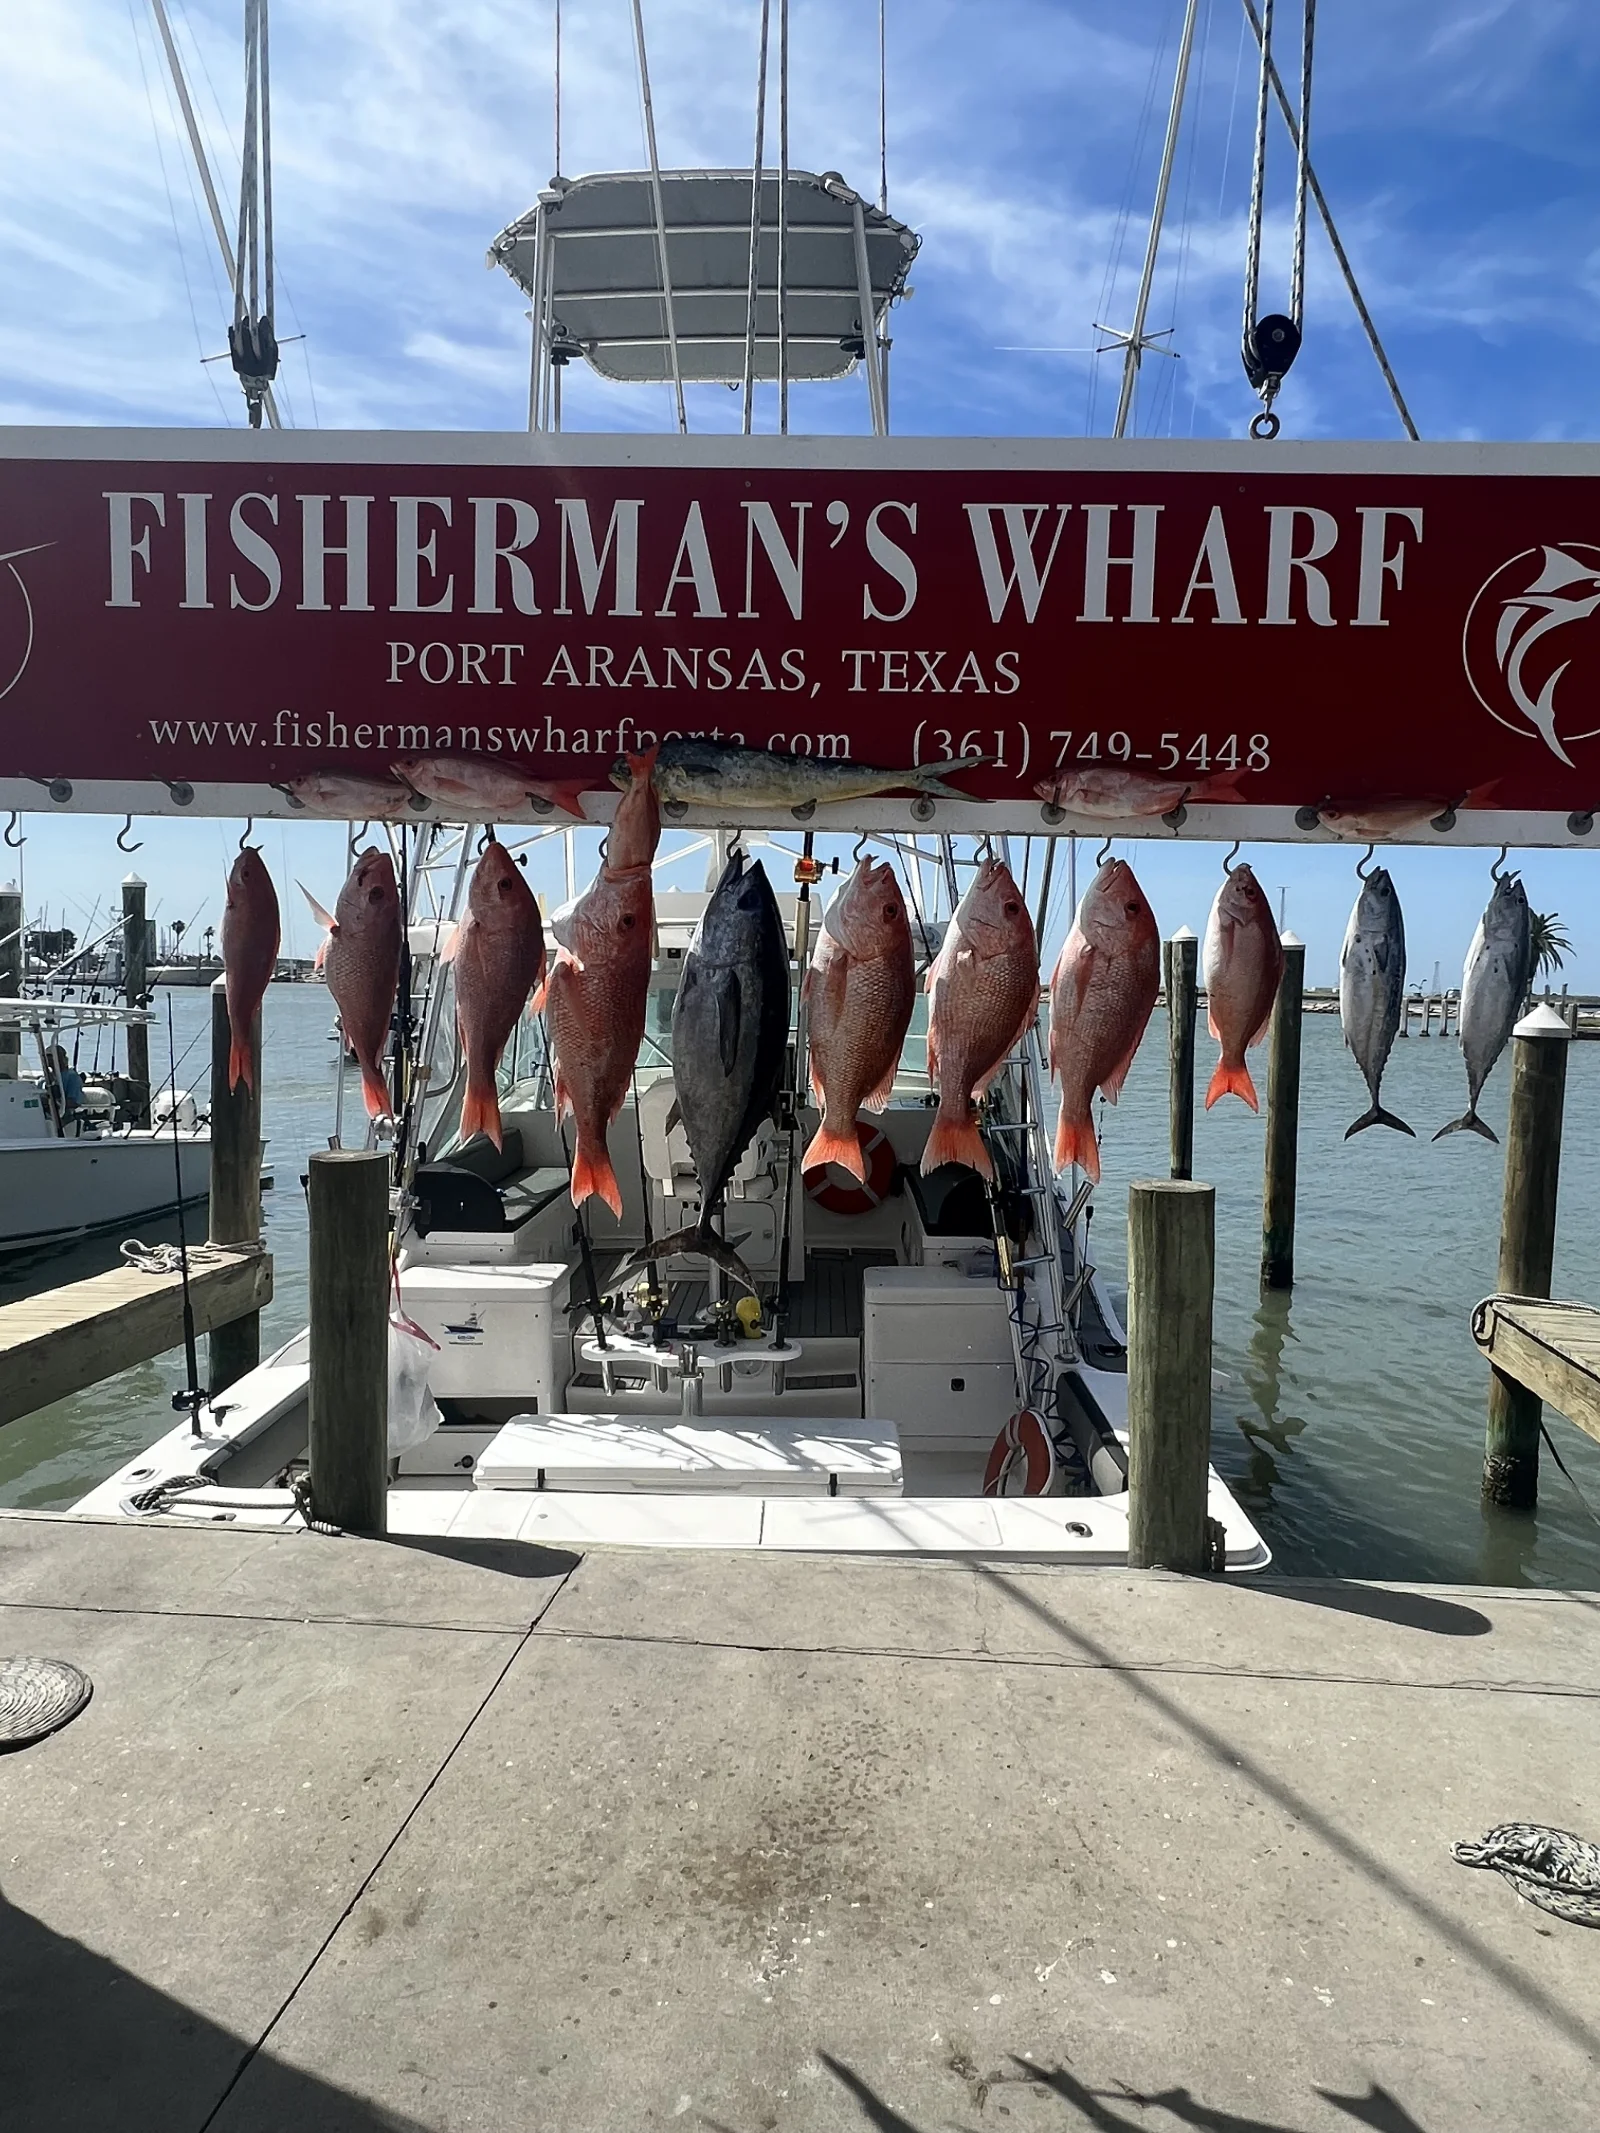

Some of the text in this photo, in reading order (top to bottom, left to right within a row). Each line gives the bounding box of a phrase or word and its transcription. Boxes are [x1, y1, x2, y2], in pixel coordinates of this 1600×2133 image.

[102, 491, 1424, 627] FISHERMAN'S WHARF
[386, 641, 1020, 699] PORT ARANSAS, TEXAS
[148, 709, 1271, 779] www.fishermanswharfptcom (361) 749-5448
